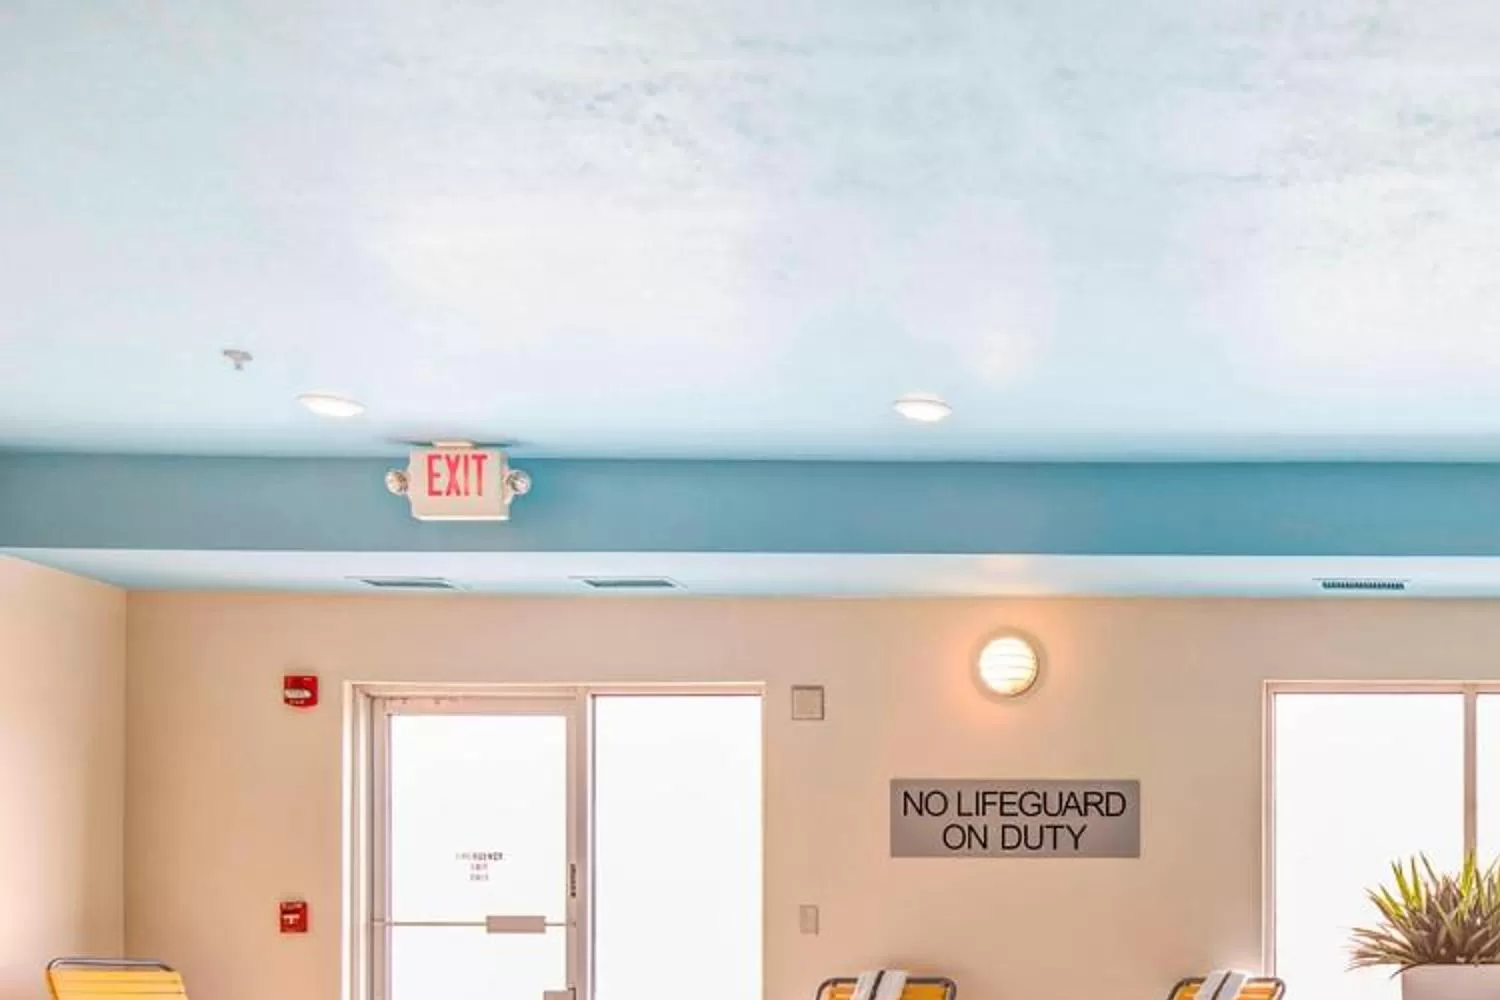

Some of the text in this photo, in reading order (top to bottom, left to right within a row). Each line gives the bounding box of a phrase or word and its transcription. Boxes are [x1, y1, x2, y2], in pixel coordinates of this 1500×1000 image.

[427, 453, 487, 497] EXIT
[903, 790, 1126, 817] NO LIFEGUARD
[943, 824, 1087, 850] ON DUTY
